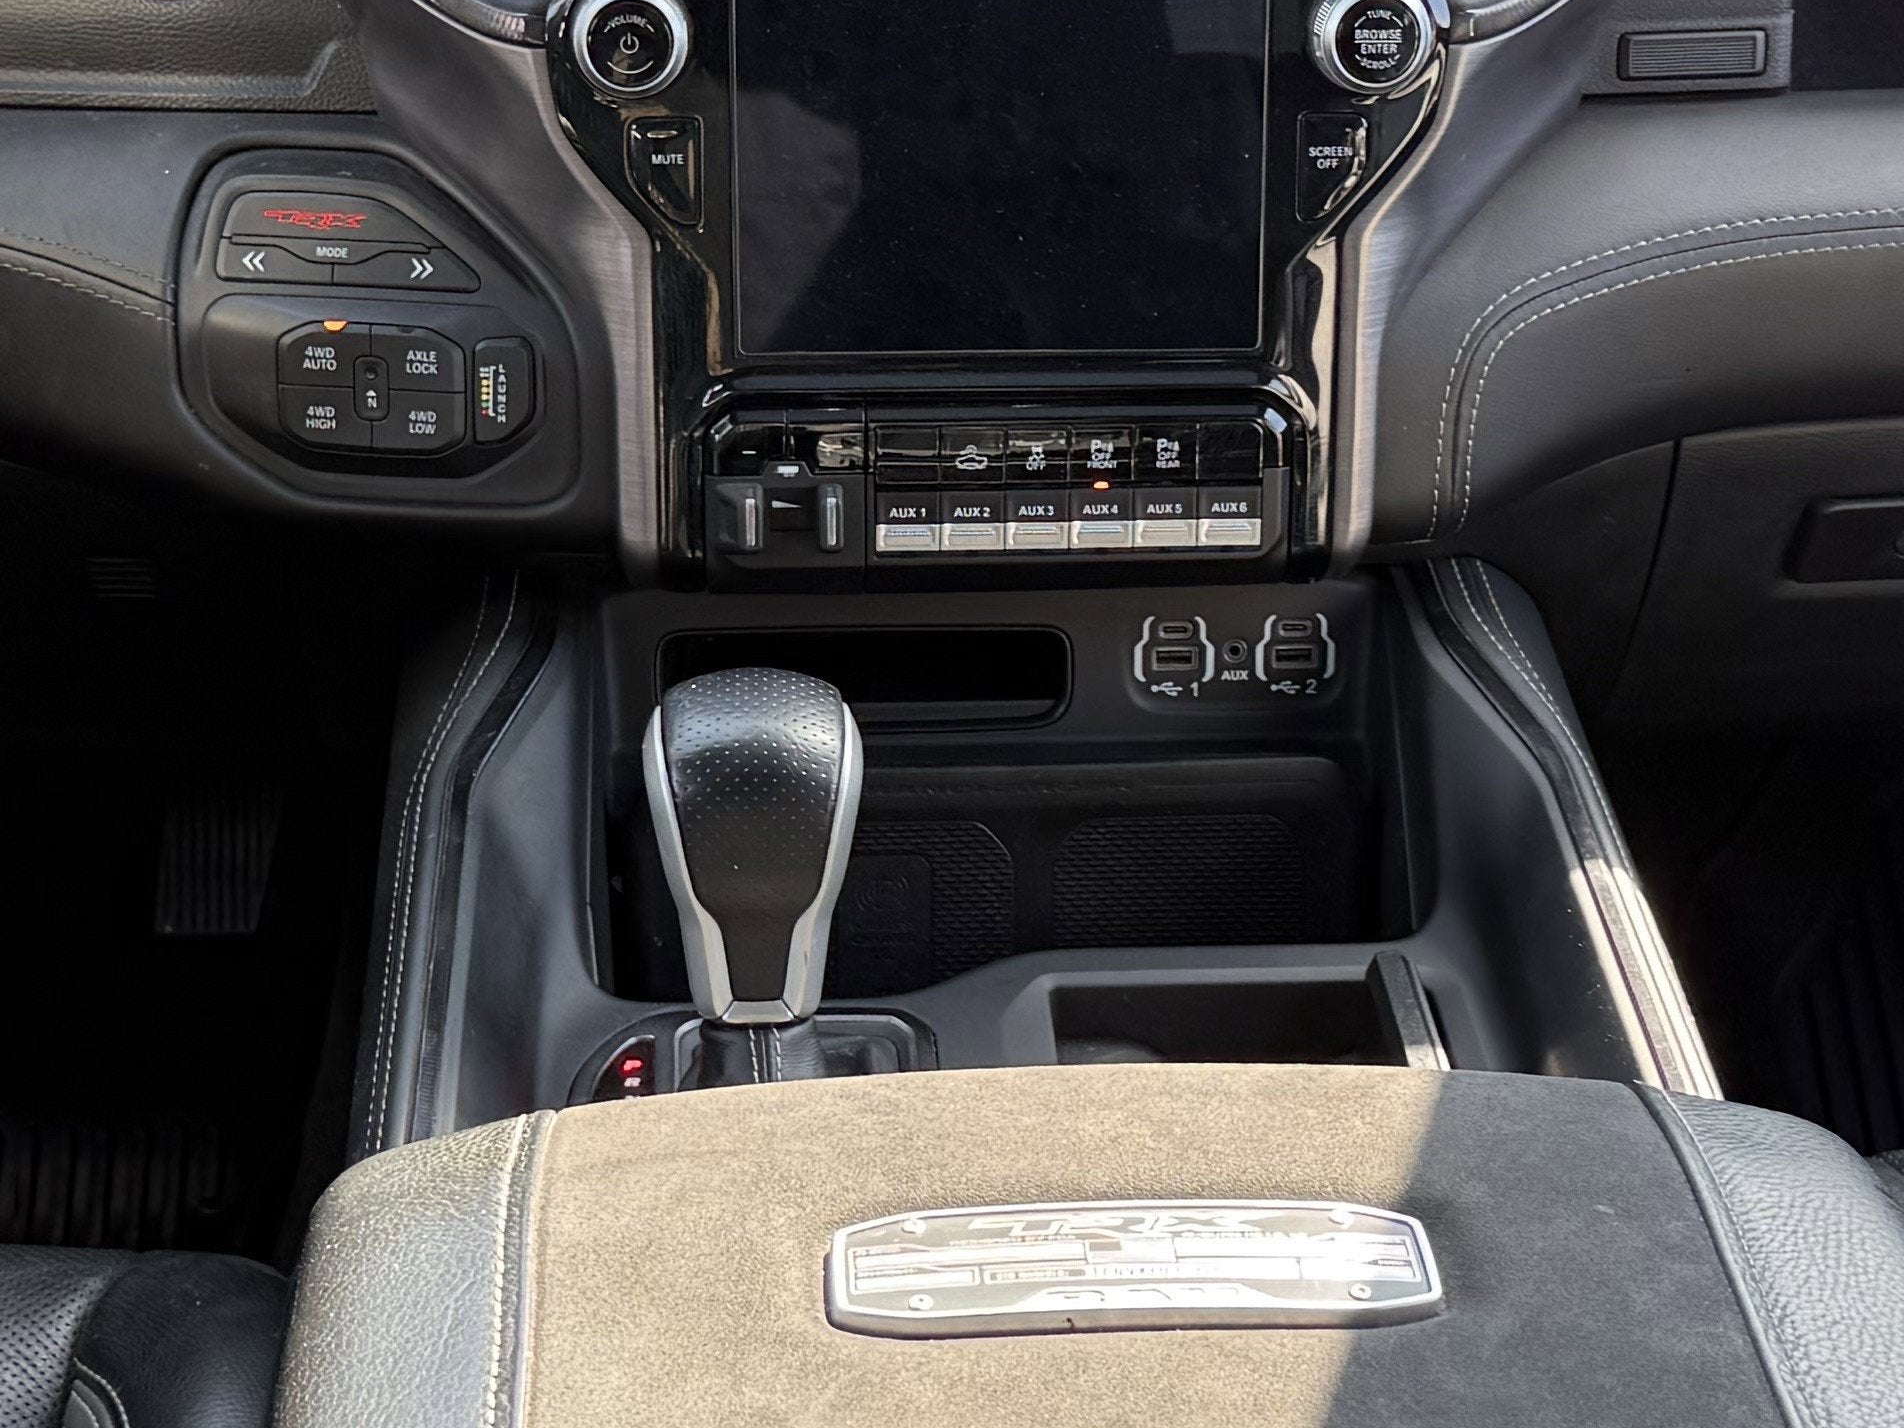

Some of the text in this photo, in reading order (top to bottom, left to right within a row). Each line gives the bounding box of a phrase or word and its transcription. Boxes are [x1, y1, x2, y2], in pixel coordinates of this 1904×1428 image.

[1366, 10, 1392, 21] TUNE
[608, 14, 648, 29] VOLUME
[1354, 29, 1403, 40] BROWSE
[1360, 44, 1398, 55] ENTER
[1360, 58, 1397, 70] SCROLL
[1308, 146, 1354, 157] SCREEN
[651, 154, 685, 165] MUTE
[1316, 158, 1340, 169] OFF
[316, 247, 348, 258] MODE
[305, 346, 335, 358] 4WD
[406, 350, 437, 363] AXLE
[303, 359, 337, 371] AUTO
[406, 363, 438, 375] LOCK
[498, 364, 507, 423] LAUNCH
[367, 398, 377, 408] N
[307, 406, 335, 418] 4WD
[408, 411, 437, 422] 4WD
[306, 418, 336, 430] HIGH
[409, 423, 437, 434] LOW
[1087, 460, 1117, 469] FRONT
[1156, 460, 1181, 468] REAR
[889, 507, 926, 518] AUX 1
[954, 507, 990, 517] AUX 2
[1018, 506, 1054, 516] AUX 3
[1083, 504, 1118, 514] AUX 4
[1147, 504, 1182, 514] AUX 5
[1211, 502, 1247, 513] AUX 6
[1221, 670, 1249, 681] AUX
[1190, 682, 1199, 697] 1
[1305, 679, 1317, 694] 2
